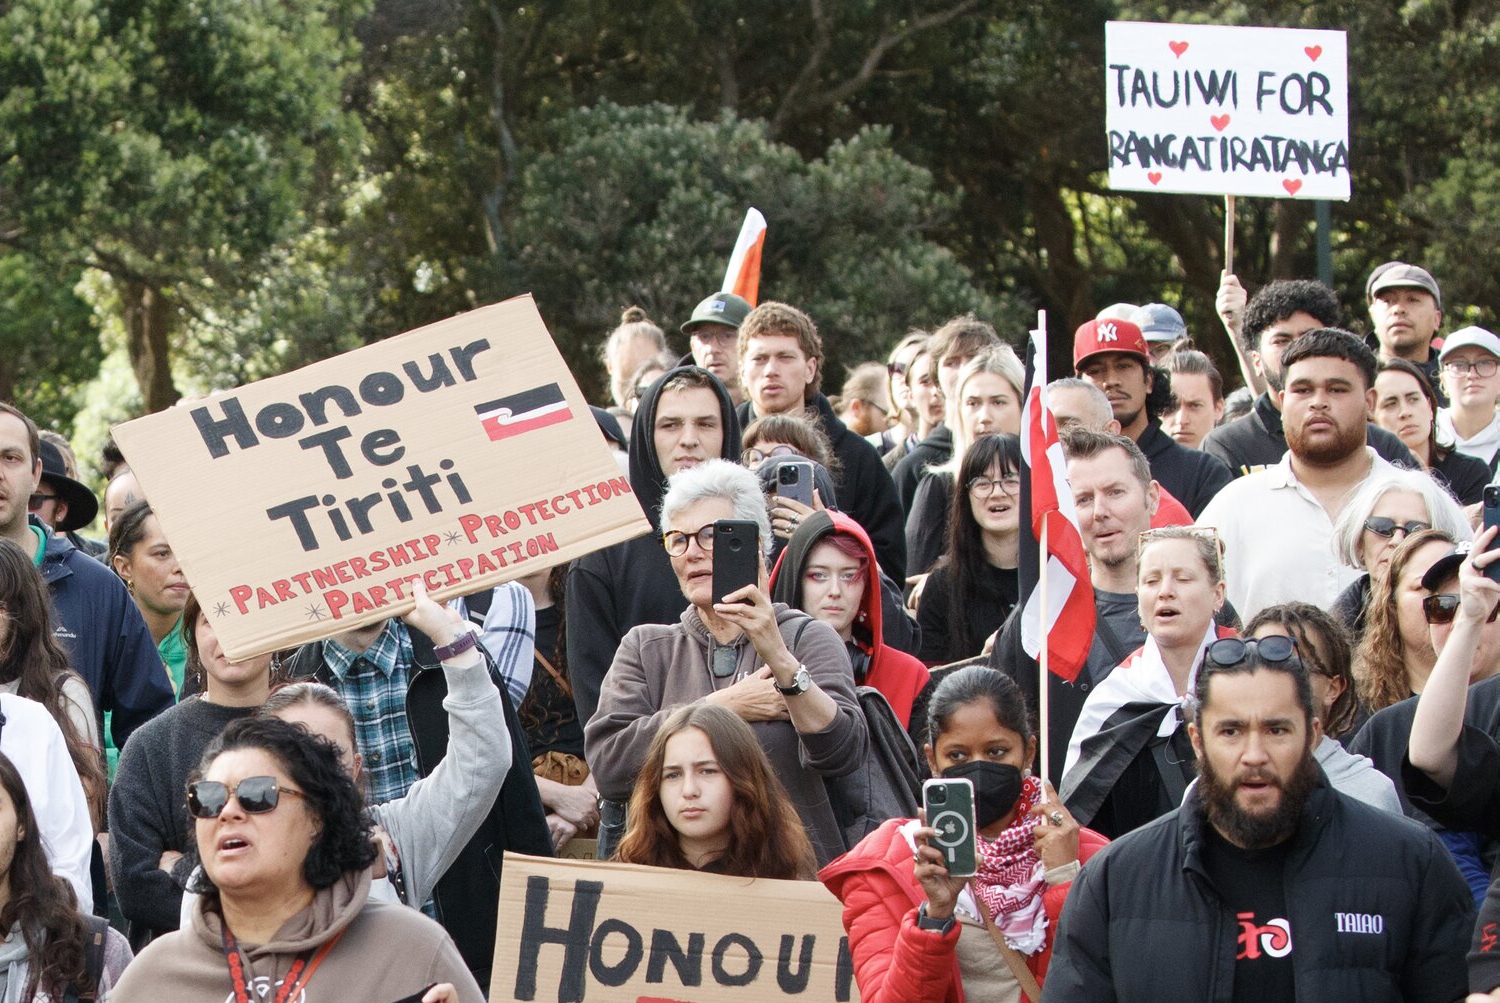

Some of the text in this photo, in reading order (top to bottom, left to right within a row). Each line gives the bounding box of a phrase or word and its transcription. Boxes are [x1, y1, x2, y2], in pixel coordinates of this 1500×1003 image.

[1109, 64, 1334, 116] TAUIWI FOR
[1108, 130, 1349, 177] RANGATIRATANGA
[190, 338, 490, 459] Honour
[298, 425, 405, 479] Te
[266, 459, 472, 552] Tiriti
[229, 475, 632, 615] PARTNERSHIP PROTECTION
